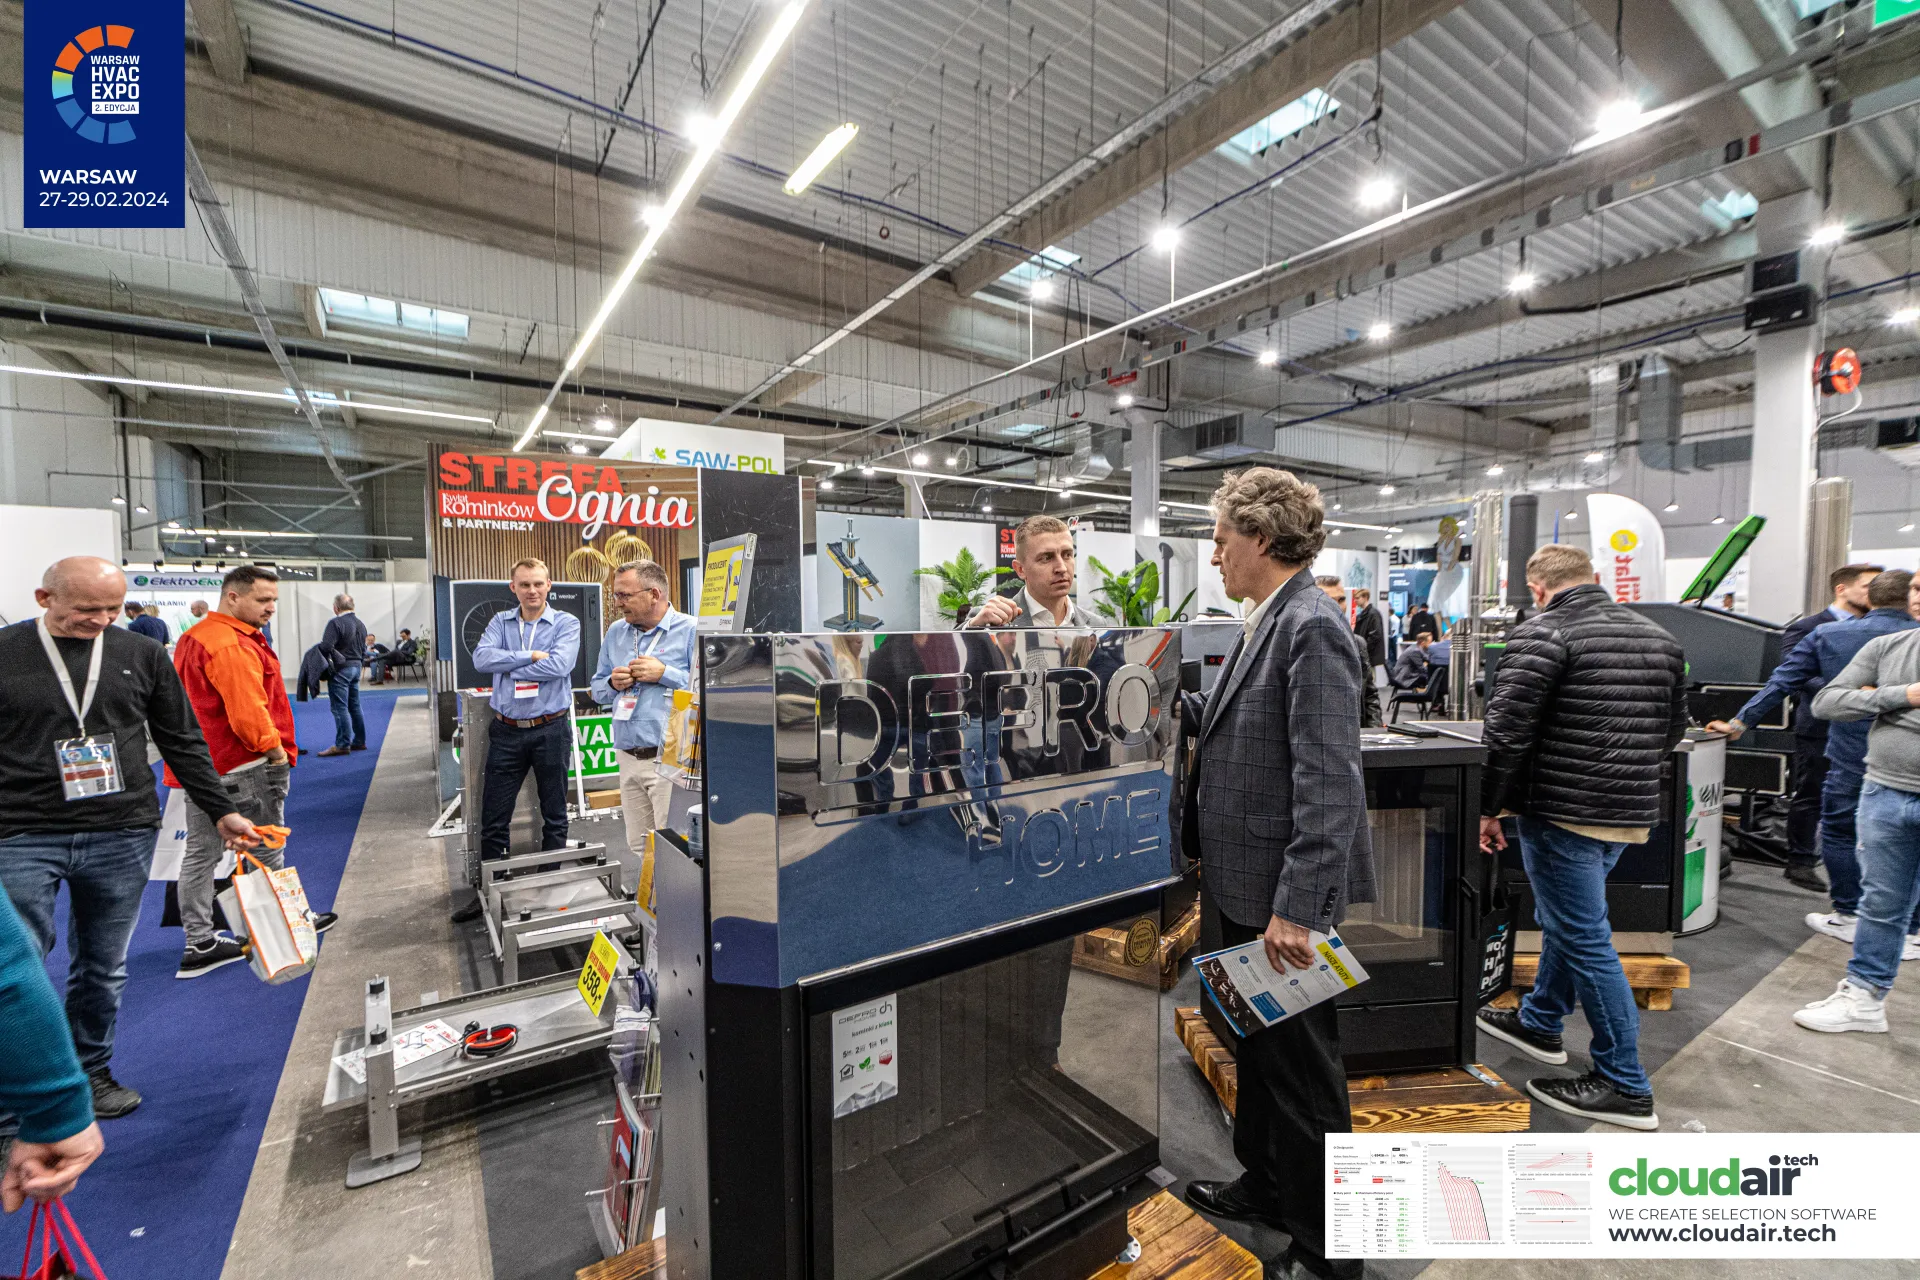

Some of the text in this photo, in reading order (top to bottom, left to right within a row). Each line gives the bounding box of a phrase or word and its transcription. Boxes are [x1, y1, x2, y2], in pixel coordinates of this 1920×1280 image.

[439, 451, 625, 497] STREFA
[675, 449, 779, 475] SAW-POL
[442, 518, 535, 531] & PARTNERZY
[537, 475, 696, 540] Ognia
[814, 663, 1163, 786] DEFRO
[966, 788, 1162, 892] HOME
